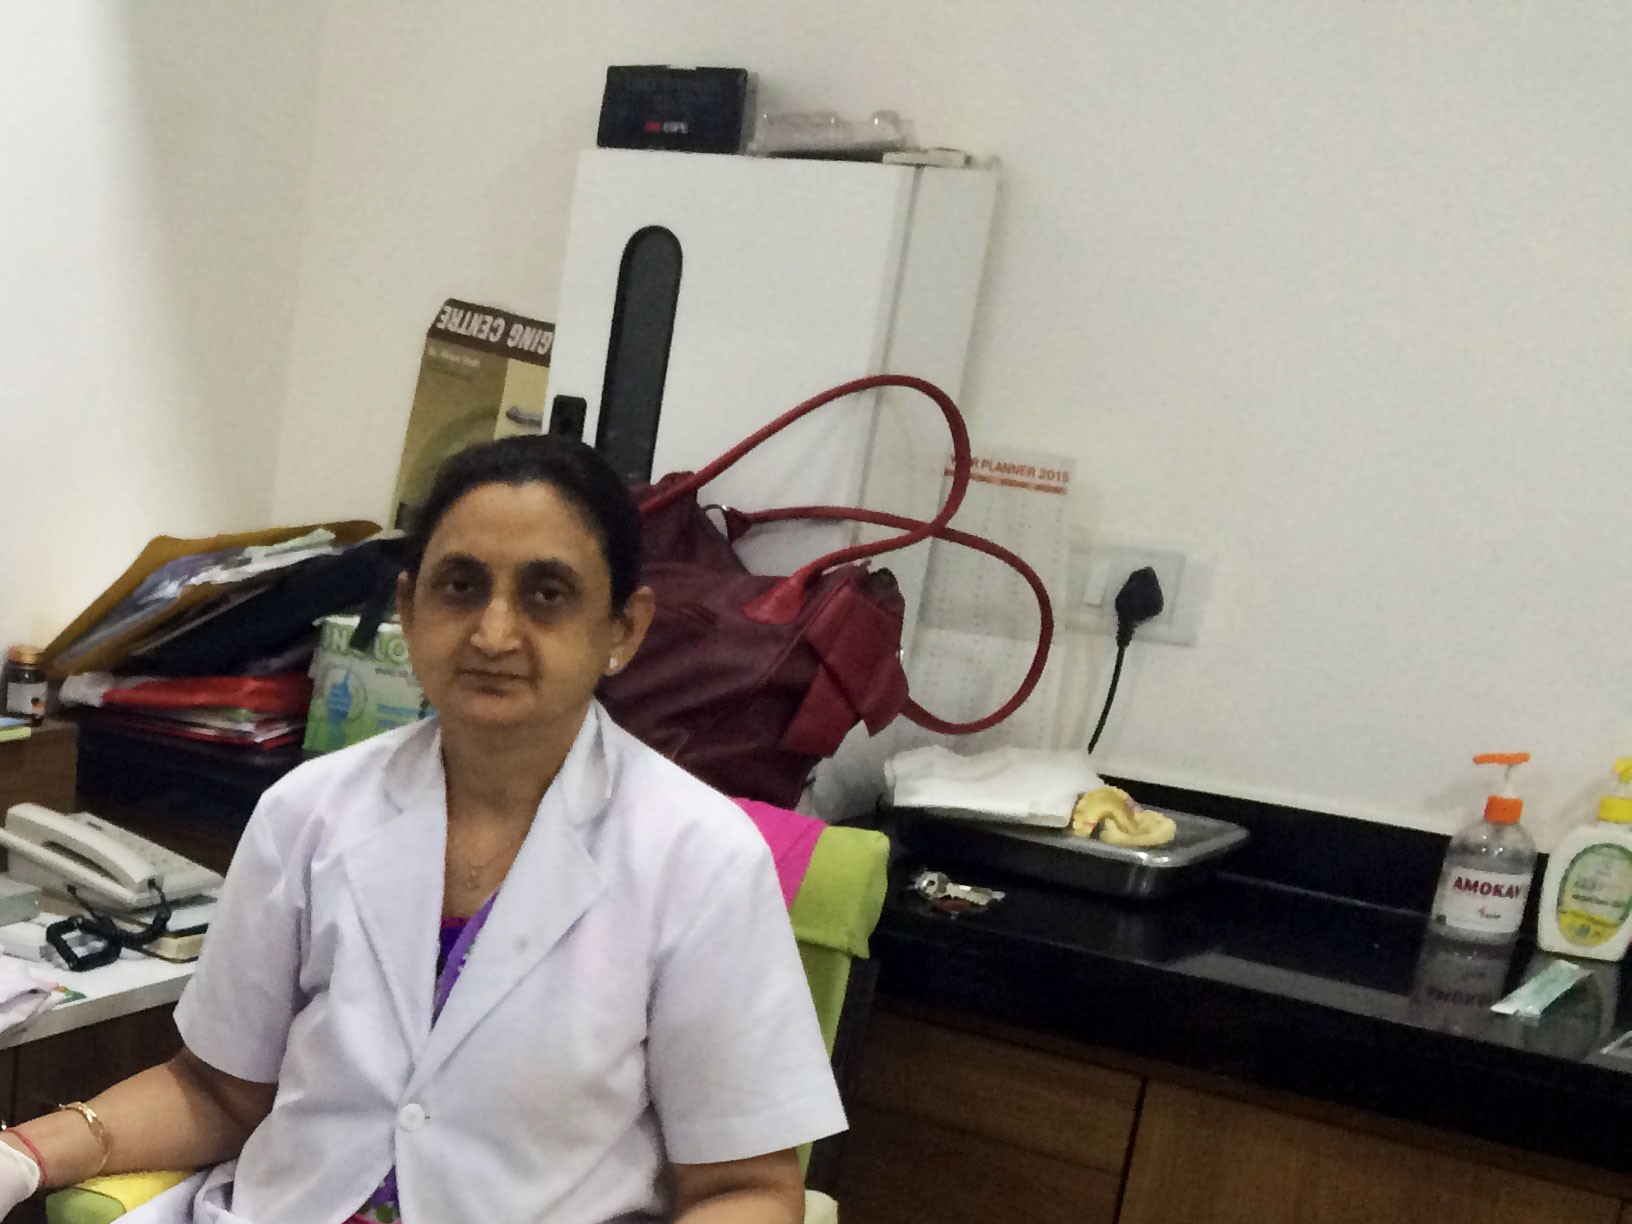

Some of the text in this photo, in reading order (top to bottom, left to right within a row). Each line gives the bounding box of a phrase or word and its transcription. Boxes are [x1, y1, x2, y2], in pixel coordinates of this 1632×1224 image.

[435, 305, 506, 343] CENTRE
[981, 458, 1037, 478] PLANNER
[1038, 467, 1070, 483] 2015
